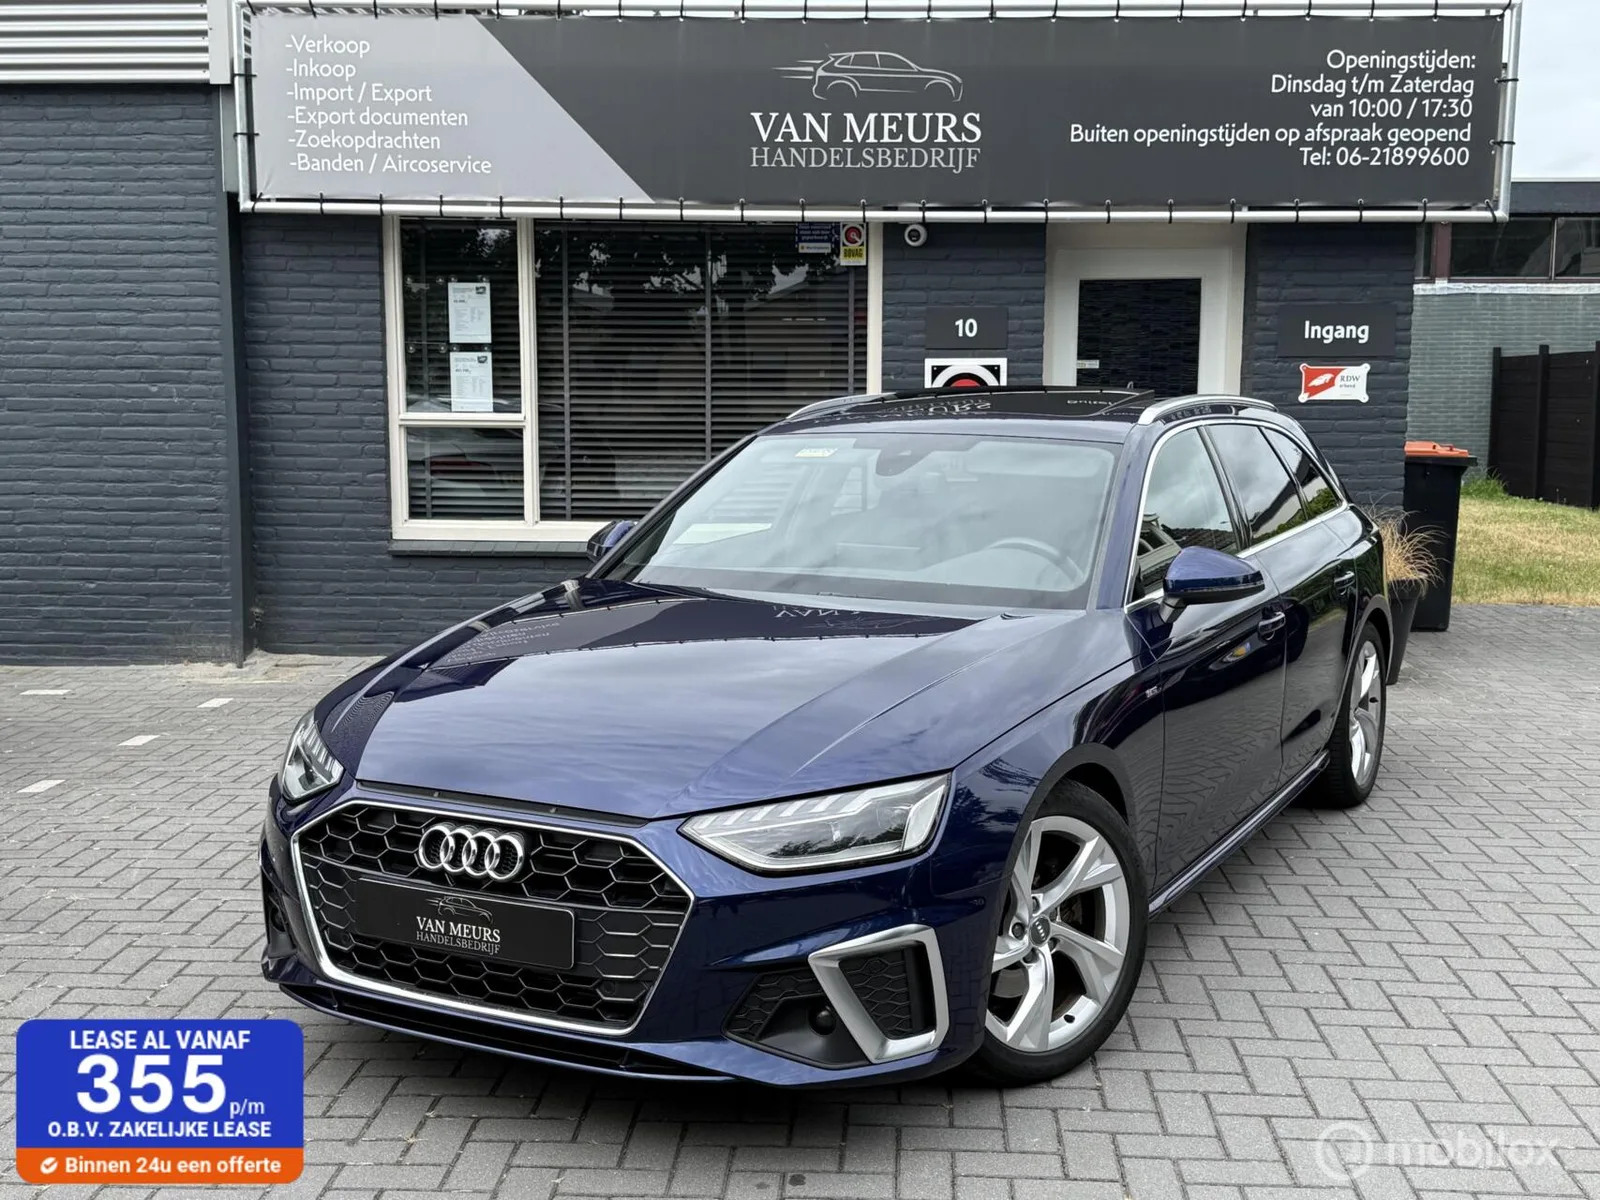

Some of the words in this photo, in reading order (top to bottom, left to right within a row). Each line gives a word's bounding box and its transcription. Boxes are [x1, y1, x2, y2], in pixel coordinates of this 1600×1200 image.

[285, 34, 370, 57] -Verkoop
[286, 58, 356, 81] -Inkoop
[1326, 49, 1476, 73] Openingstijden:
[287, 83, 354, 104] -Import
[372, 83, 432, 106] Export
[1272, 74, 1346, 96] Dinsdag
[1351, 73, 1384, 94] t/m
[1389, 74, 1475, 97] Zaterdag
[288, 106, 356, 129] -Export
[360, 106, 468, 127] documenten
[1311, 104, 1343, 117] van
[1350, 99, 1402, 117] 10:00
[1421, 98, 1473, 117] 17:30
[751, 113, 831, 142] VAN
[843, 113, 981, 142] MEURS
[1071, 124, 1128, 142] Buiten
[1134, 123, 1269, 146] openingstijden
[1275, 129, 1300, 146] op
[1305, 122, 1383, 145] afspraak
[1388, 122, 1472, 146] geopend
[288, 130, 441, 153] -Zoekopdrachten
[290, 153, 364, 173] -Banden
[383, 154, 492, 174] Aircoservice
[751, 147, 980, 173] HANDELSBEDRIJF
[1300, 147, 1331, 165] Tel:
[1336, 145, 1469, 165] 06-21899600
[955, 319, 977, 337] 10
[1304, 320, 1370, 343] Ingang
[416, 916, 446, 935] VAN
[449, 921, 501, 943] MEURS
[416, 931, 501, 955] HANDELSBEDRIJF
